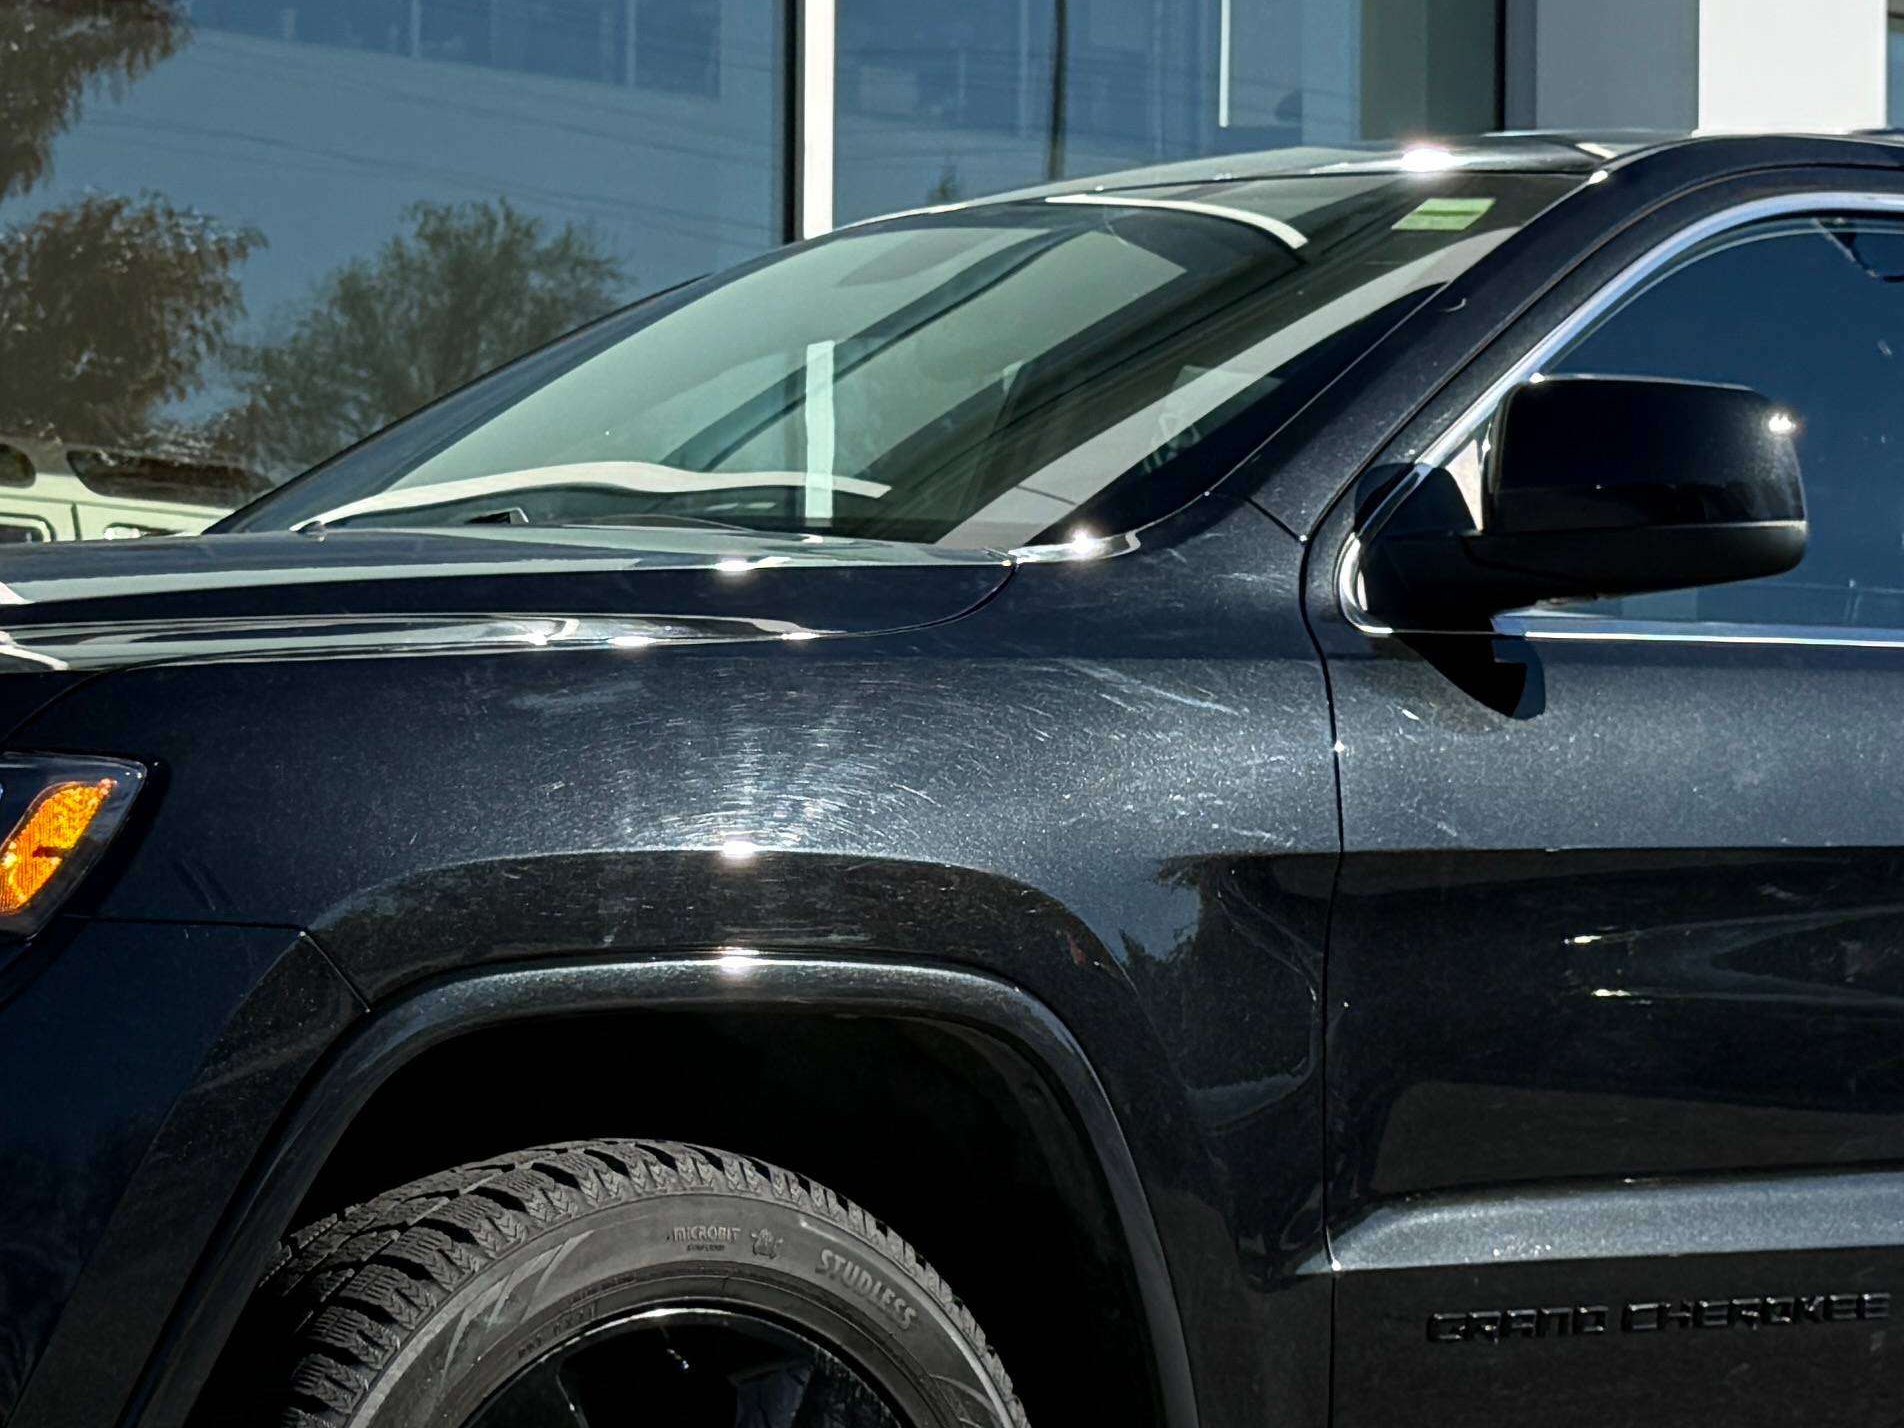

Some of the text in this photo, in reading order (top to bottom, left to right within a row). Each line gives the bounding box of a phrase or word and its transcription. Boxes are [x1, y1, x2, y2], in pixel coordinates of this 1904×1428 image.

[815, 1247, 919, 1331] STUDLESS
[1427, 1291, 1893, 1344] GRAND CHEROKEE
